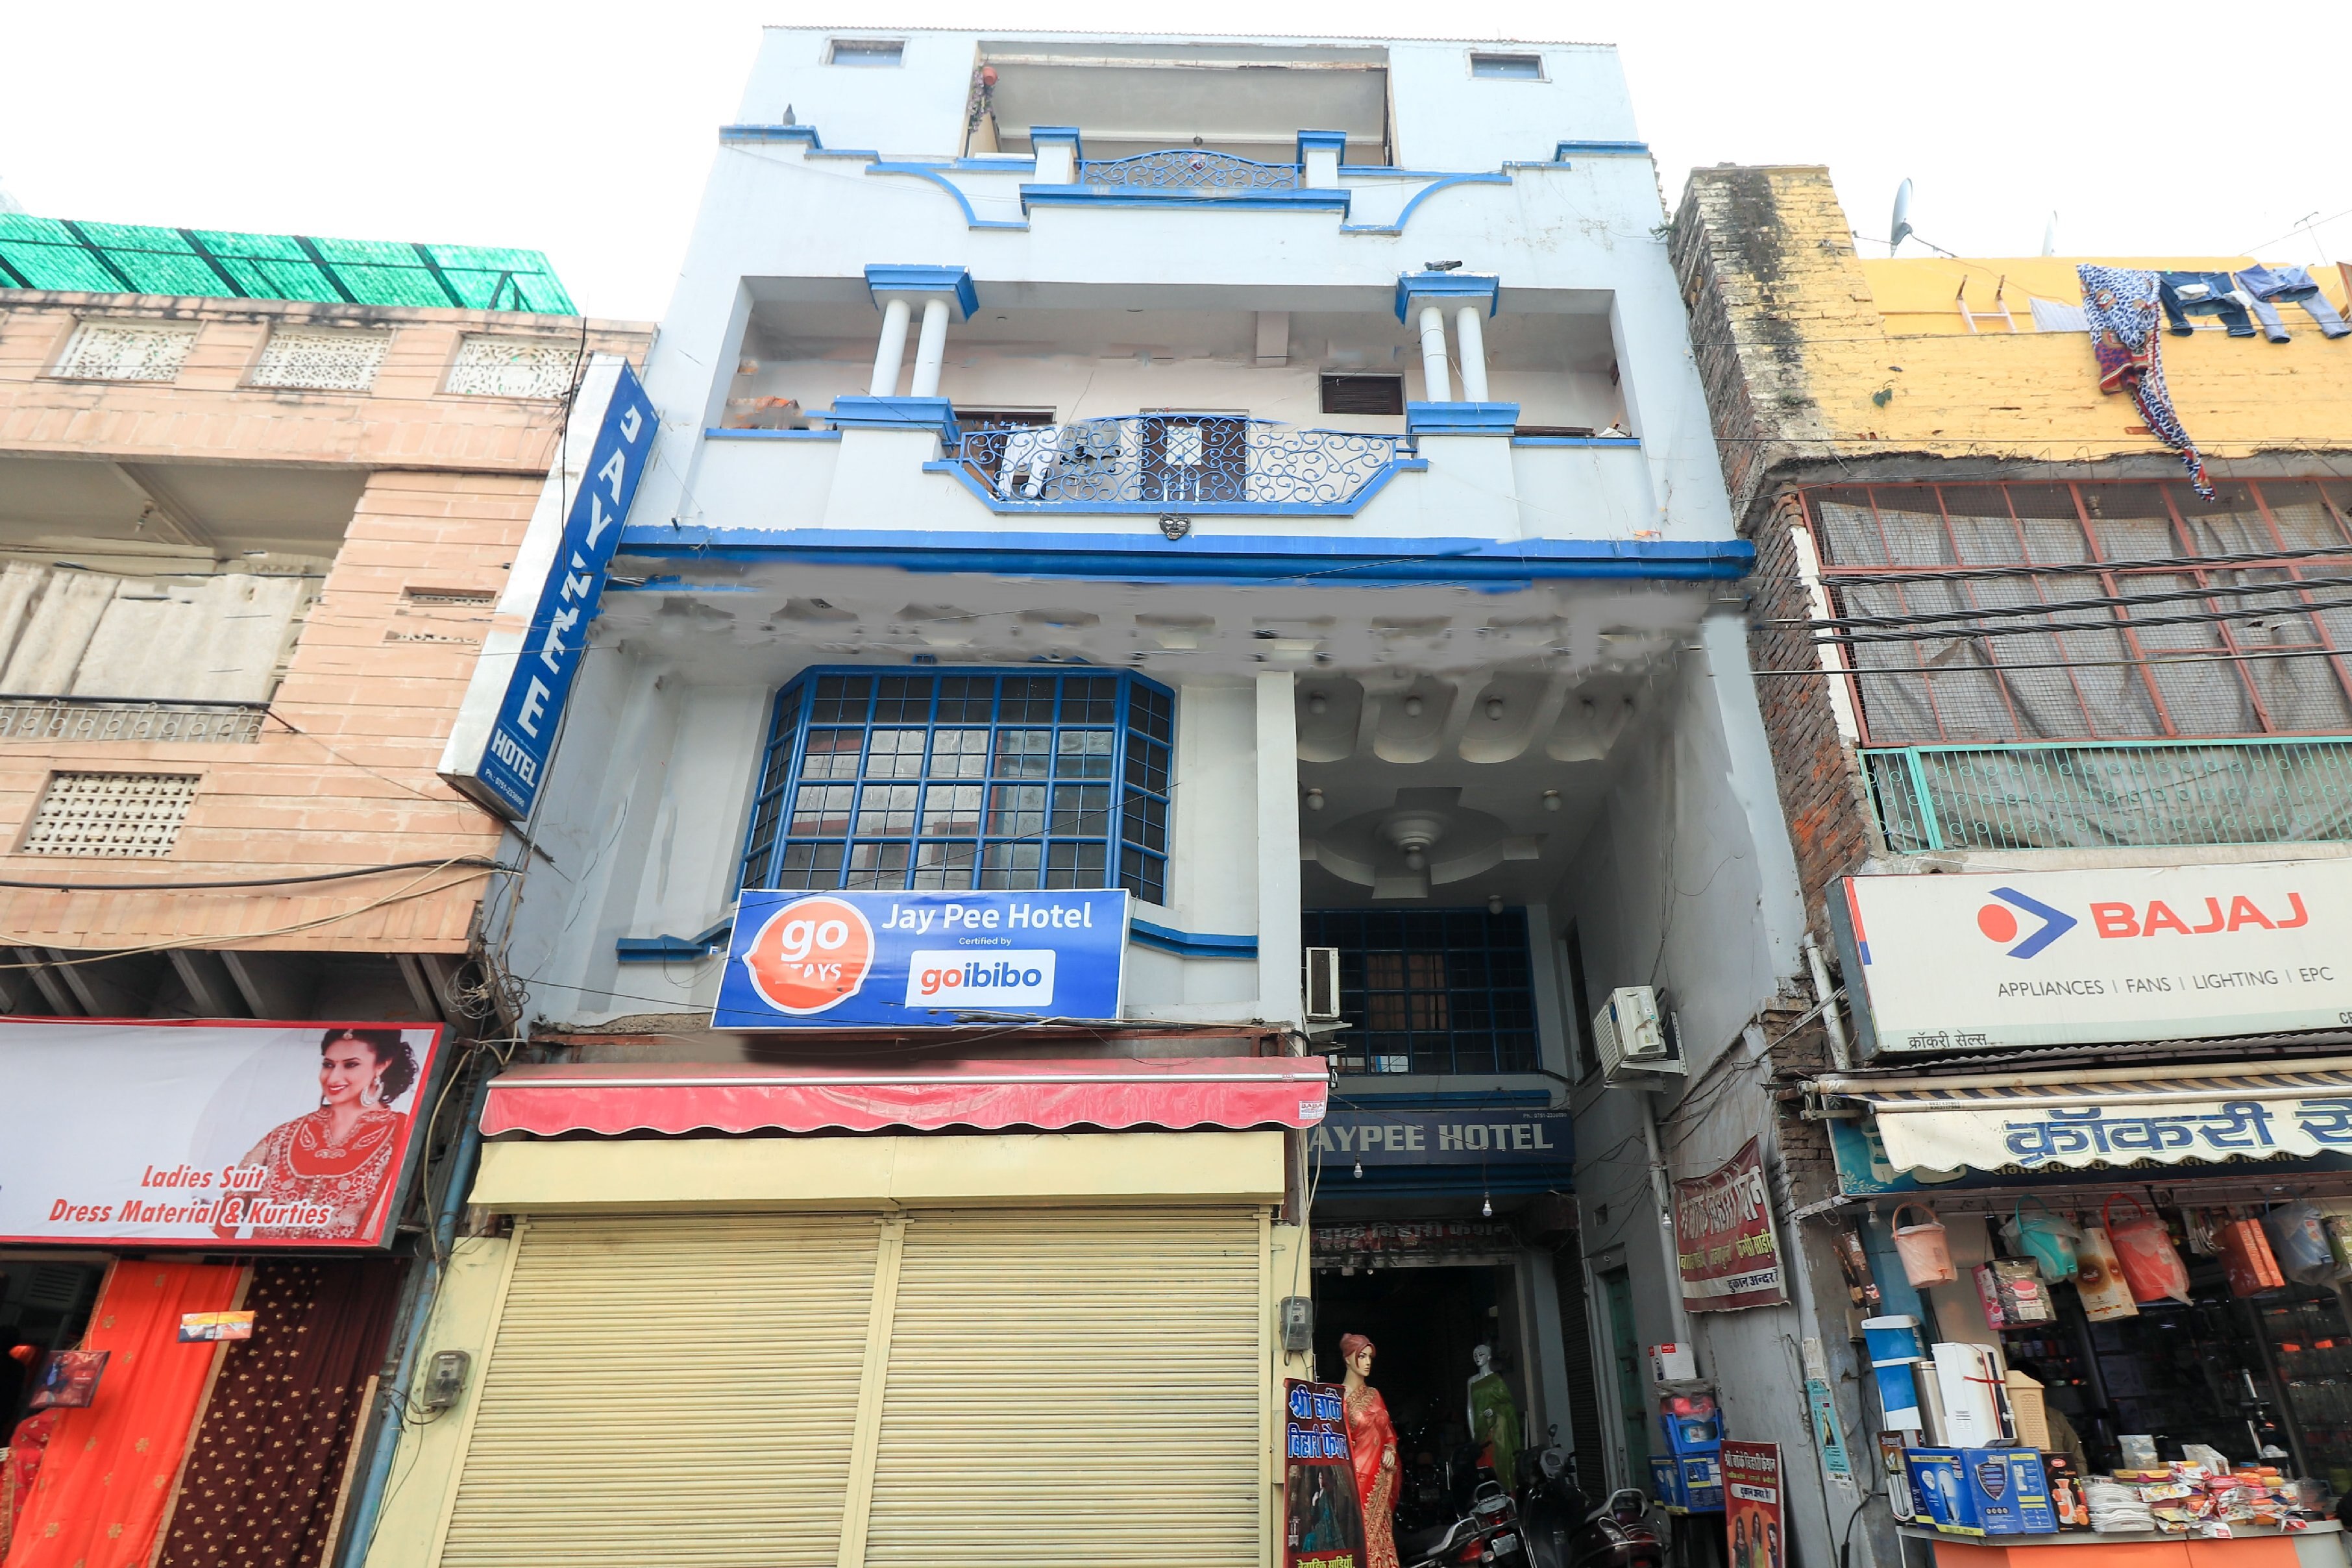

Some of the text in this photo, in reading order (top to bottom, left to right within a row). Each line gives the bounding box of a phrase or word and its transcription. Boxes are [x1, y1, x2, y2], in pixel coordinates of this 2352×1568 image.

[491, 728, 537, 788] HOTEL
[881, 901, 1092, 935] Jay Pee Hotel
[2090, 892, 2309, 939] BAJAJ
[781, 920, 849, 962] go
[959, 936, 1012, 947] Certified by
[920, 961, 1042, 995] goibibo
[1998, 966, 2334, 998] APPLIANCES FANS LIGHTING EPC
[1907, 1029, 1987, 1049] क्रॉकरी सेल्स
[1308, 1123, 1554, 1151] AYPEE HOTEL
[2003, 1101, 2275, 1166] क्रॉकरी
[141, 1164, 265, 1190] Ladies Suit
[49, 1198, 331, 1225] Dress Material & Kurties
[1288, 1384, 1312, 1419] श्री
[1288, 1423, 1322, 1458] बिहारी
